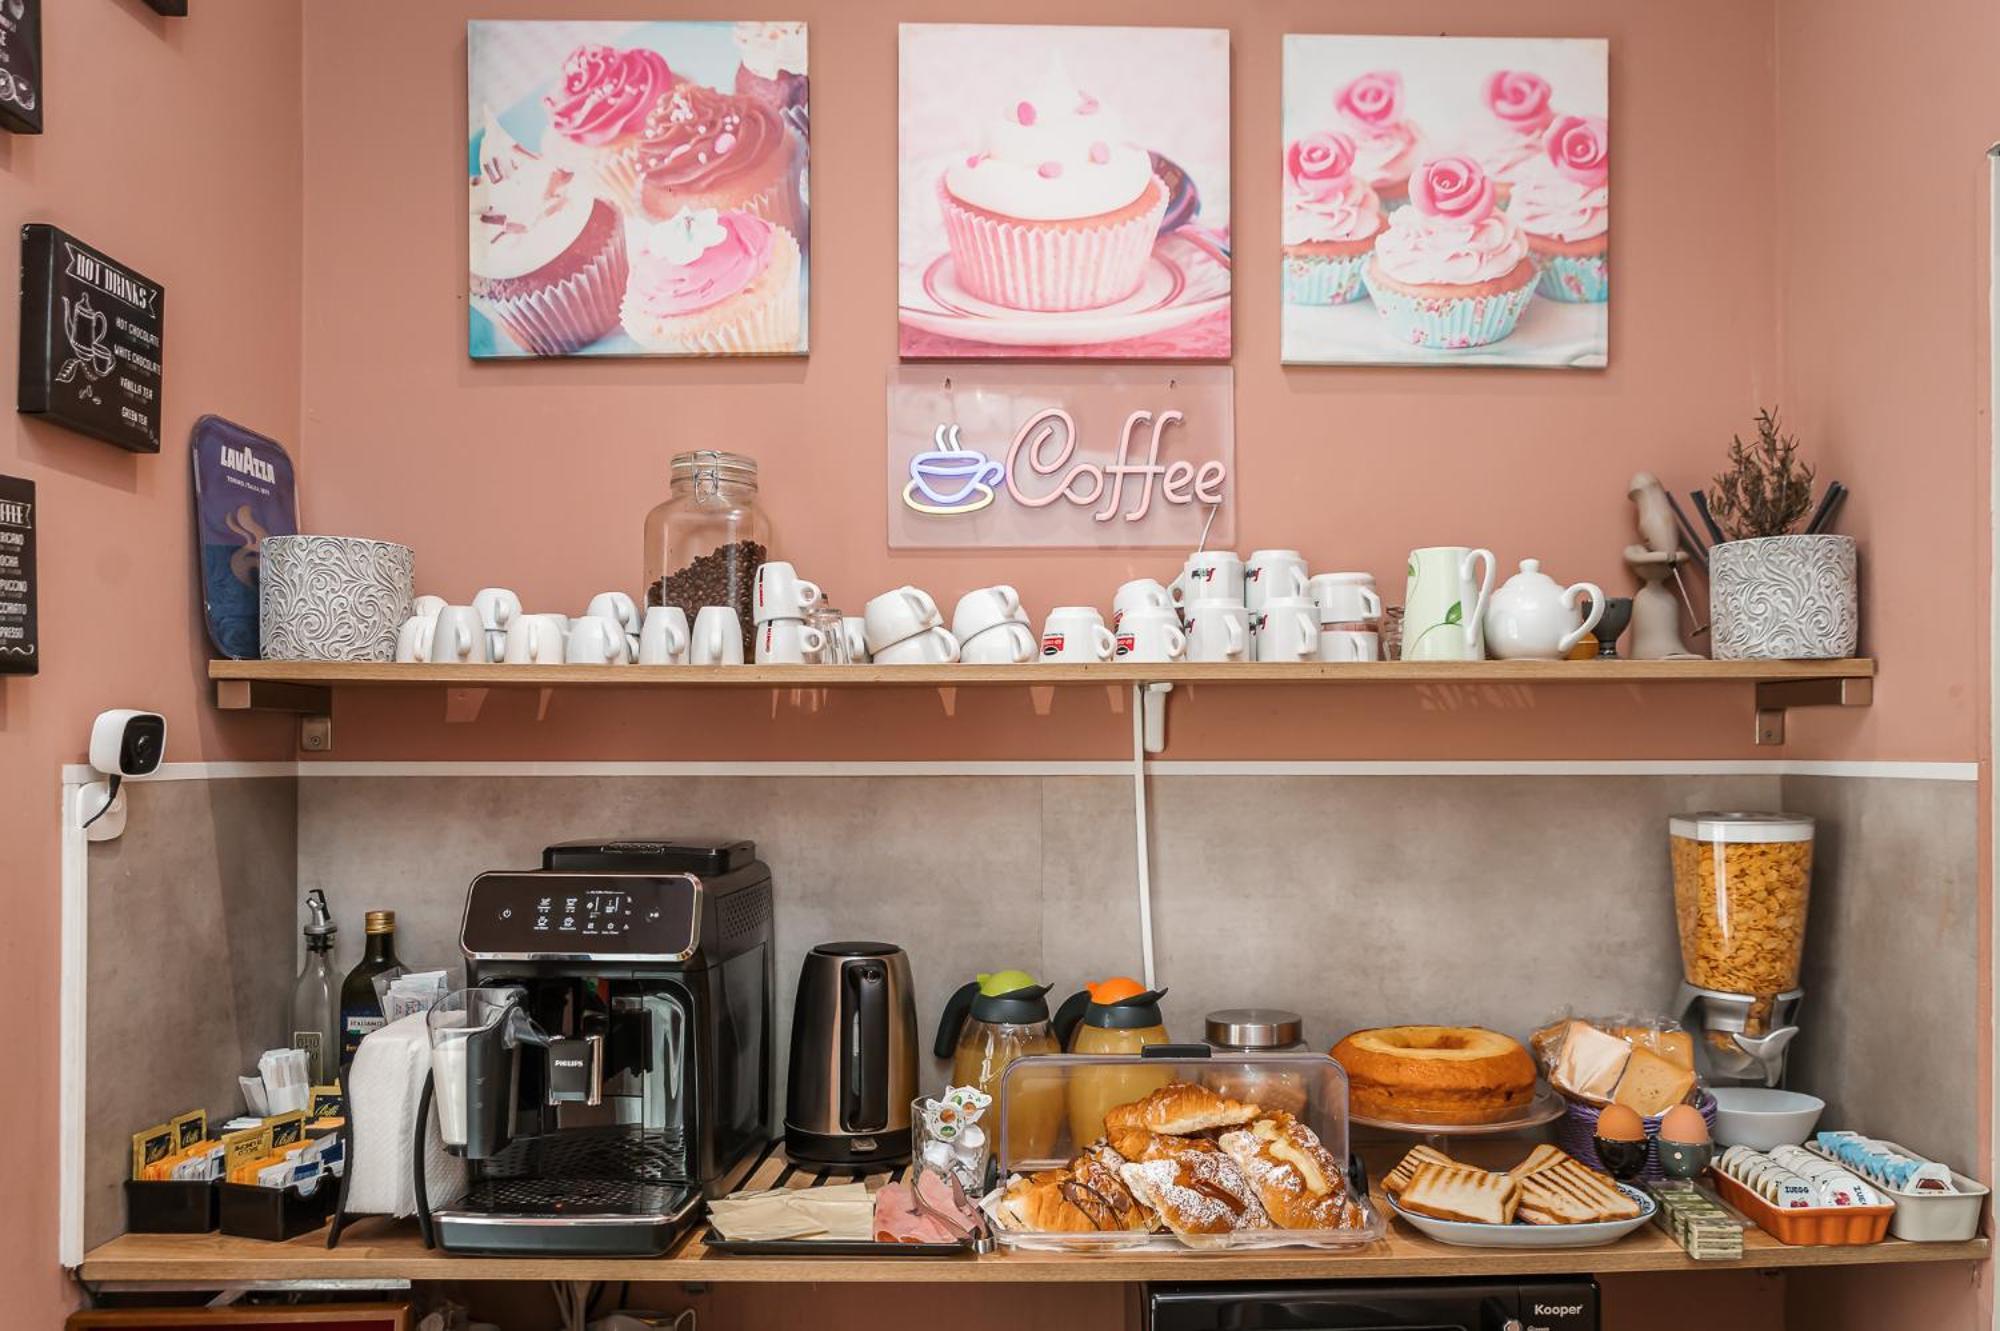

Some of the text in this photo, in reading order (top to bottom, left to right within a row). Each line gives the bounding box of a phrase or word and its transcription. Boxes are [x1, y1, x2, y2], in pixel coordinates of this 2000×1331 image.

[76, 253, 147, 309] HOT DRINKS
[220, 445, 276, 485] LAVAZZA
[1006, 408, 1226, 522] Coffee
[1534, 1303, 1584, 1318] Kooper
